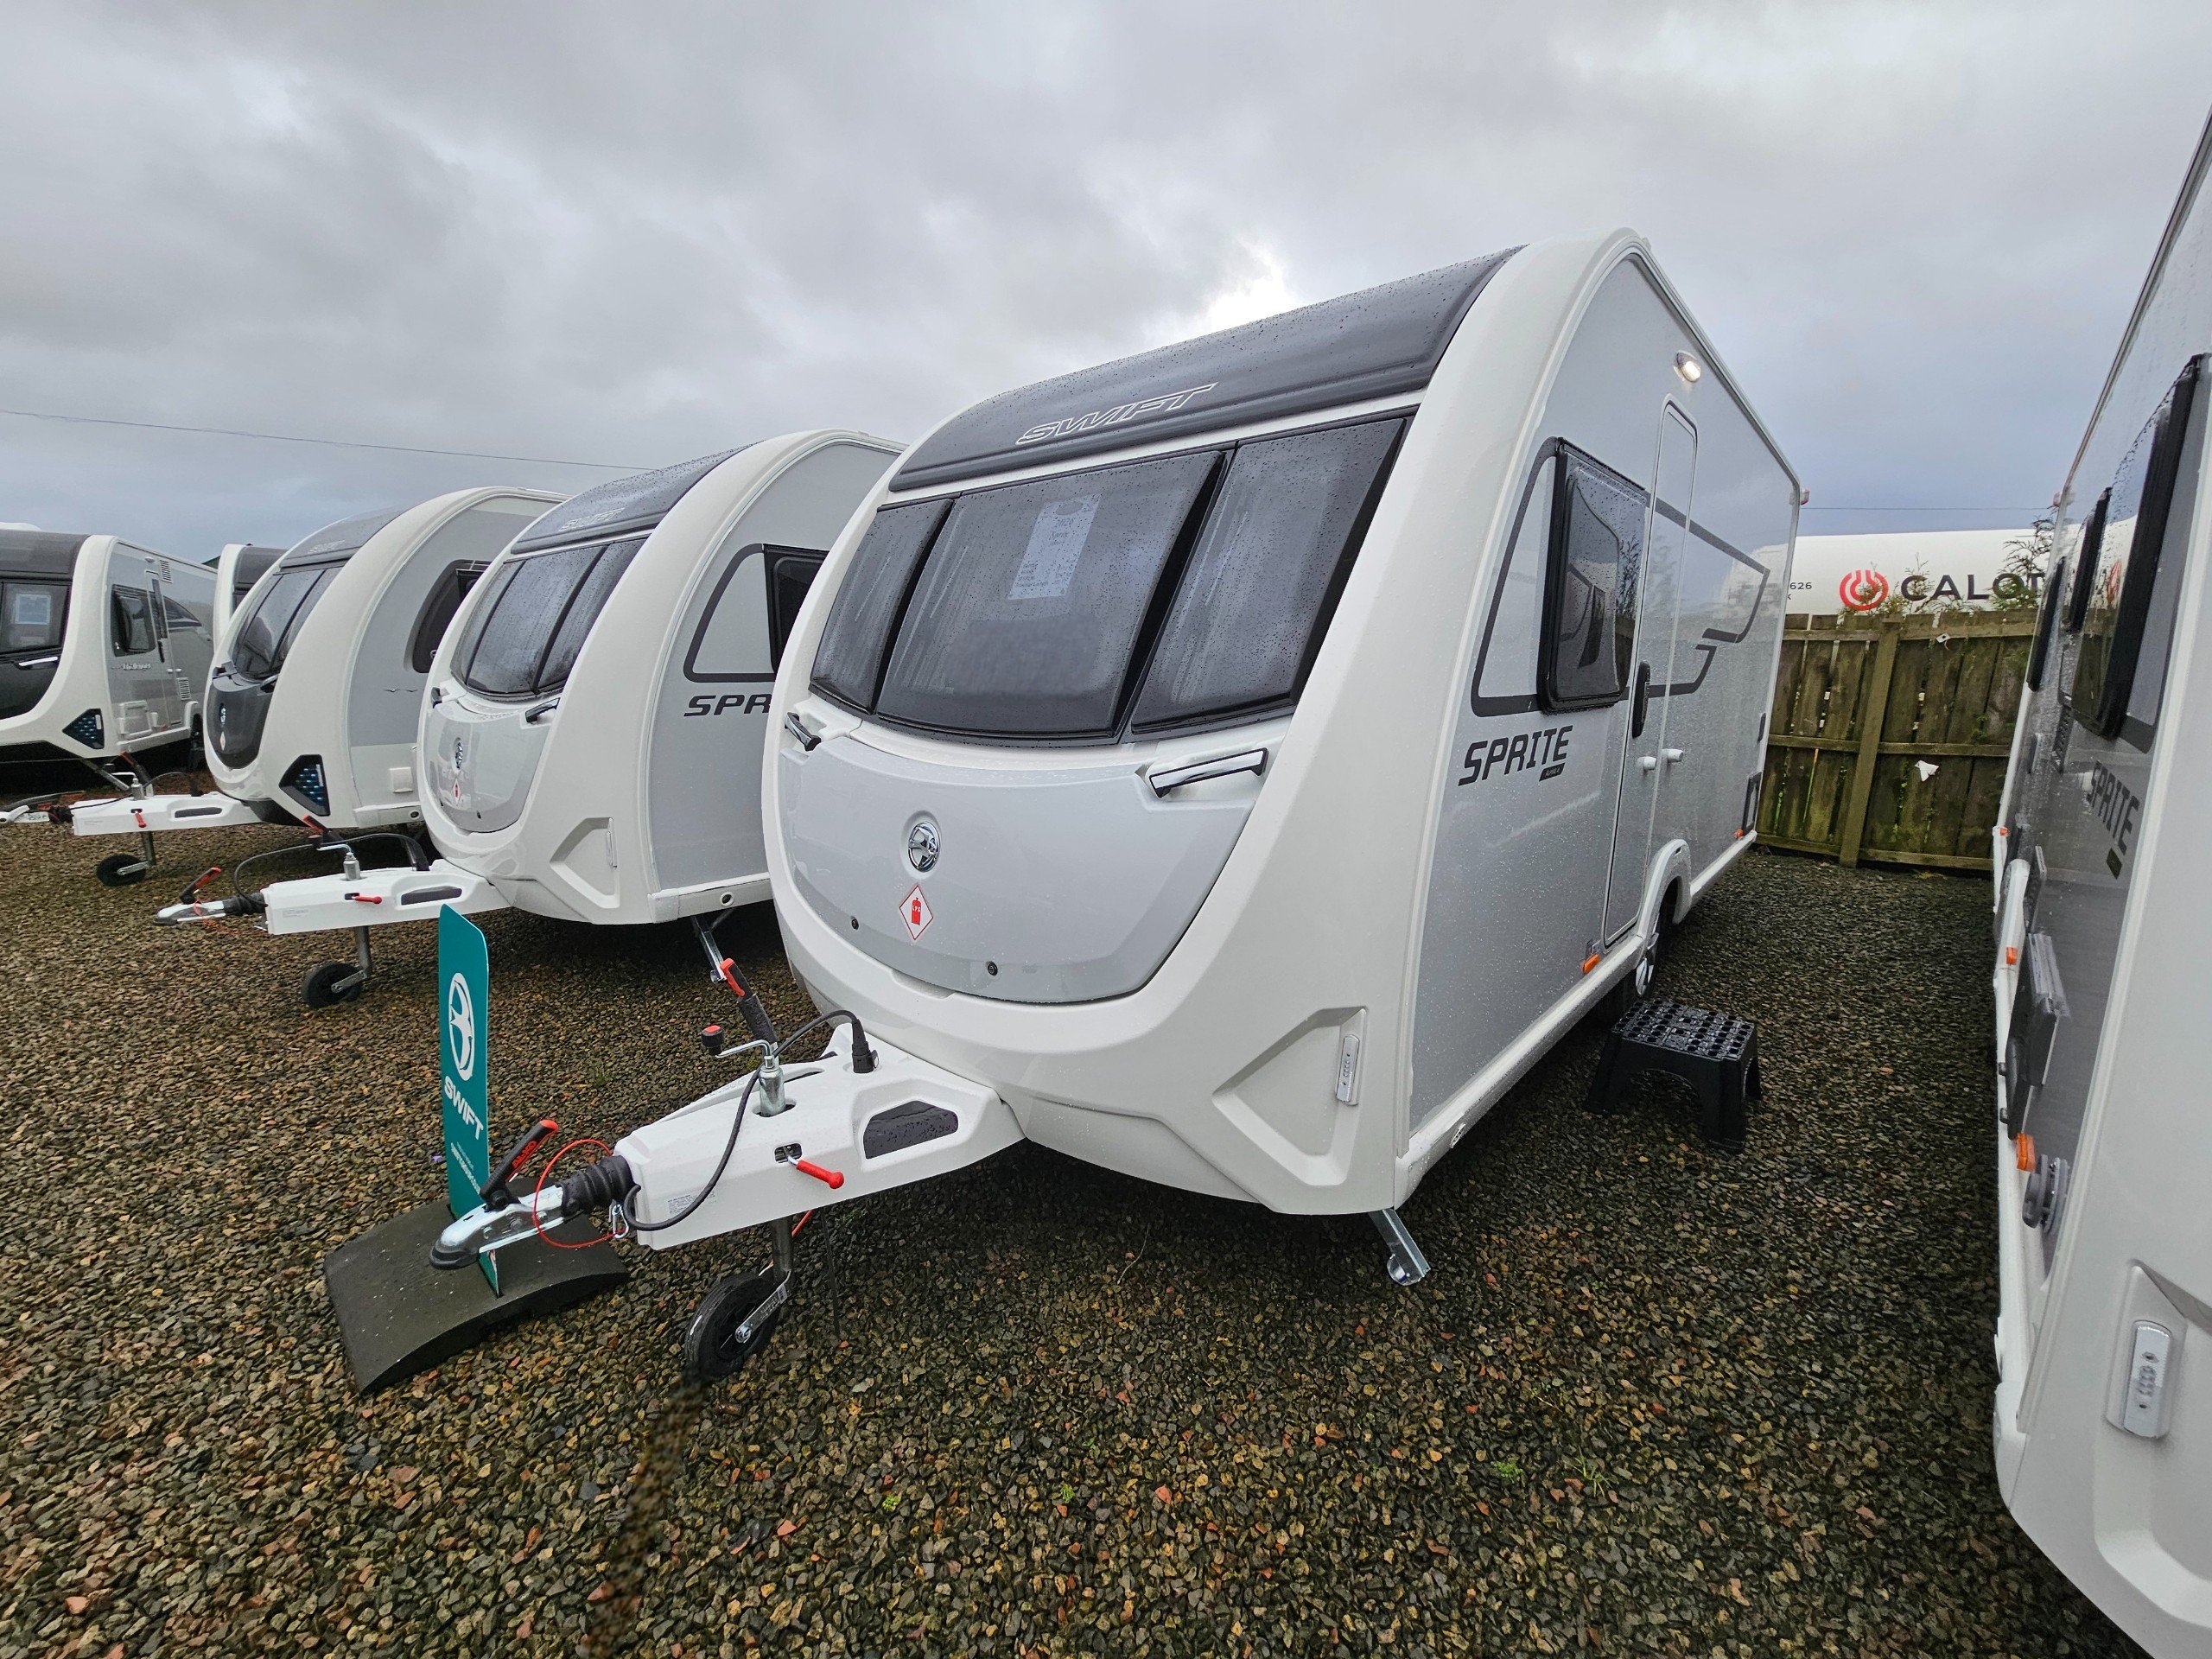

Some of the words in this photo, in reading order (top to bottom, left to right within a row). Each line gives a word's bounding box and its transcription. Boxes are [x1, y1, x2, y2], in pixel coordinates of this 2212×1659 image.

[1014, 381, 1219, 446] SWIFT
[1789, 582, 1813, 590] 626
[1458, 725, 1573, 786] SPRITE
[2086, 760, 2140, 856] SPRITE
[444, 1075, 484, 1141] SWIFT
